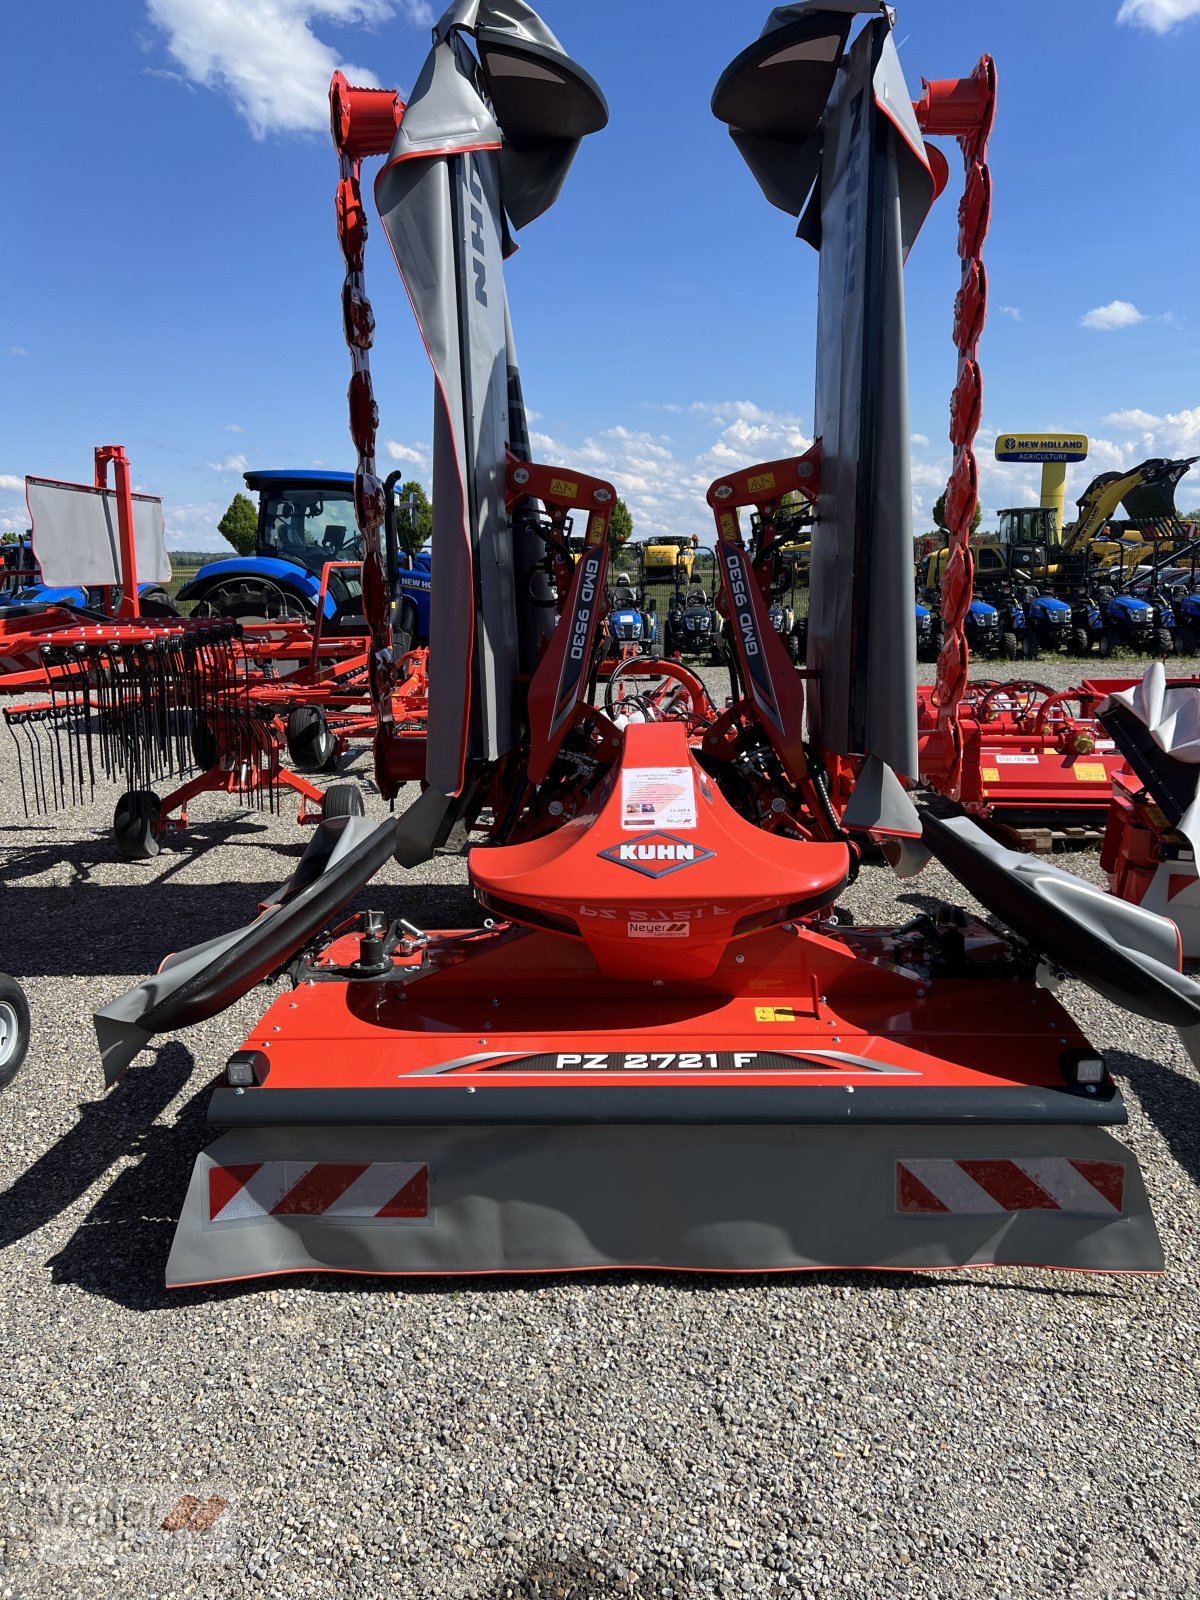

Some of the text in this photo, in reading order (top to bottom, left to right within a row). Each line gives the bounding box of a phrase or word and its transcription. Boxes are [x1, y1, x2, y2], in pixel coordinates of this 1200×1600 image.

[470, 152, 488, 307] UHN
[1041, 441, 1082, 449] HOLLAND
[401, 577, 420, 587] NEW
[570, 559, 599, 660] GMD 9530
[726, 555, 759, 656] GMD 9530
[620, 845, 694, 860] KUHN
[629, 923, 666, 934] Neyer
[556, 1052, 757, 1069] PZ 2721 F
